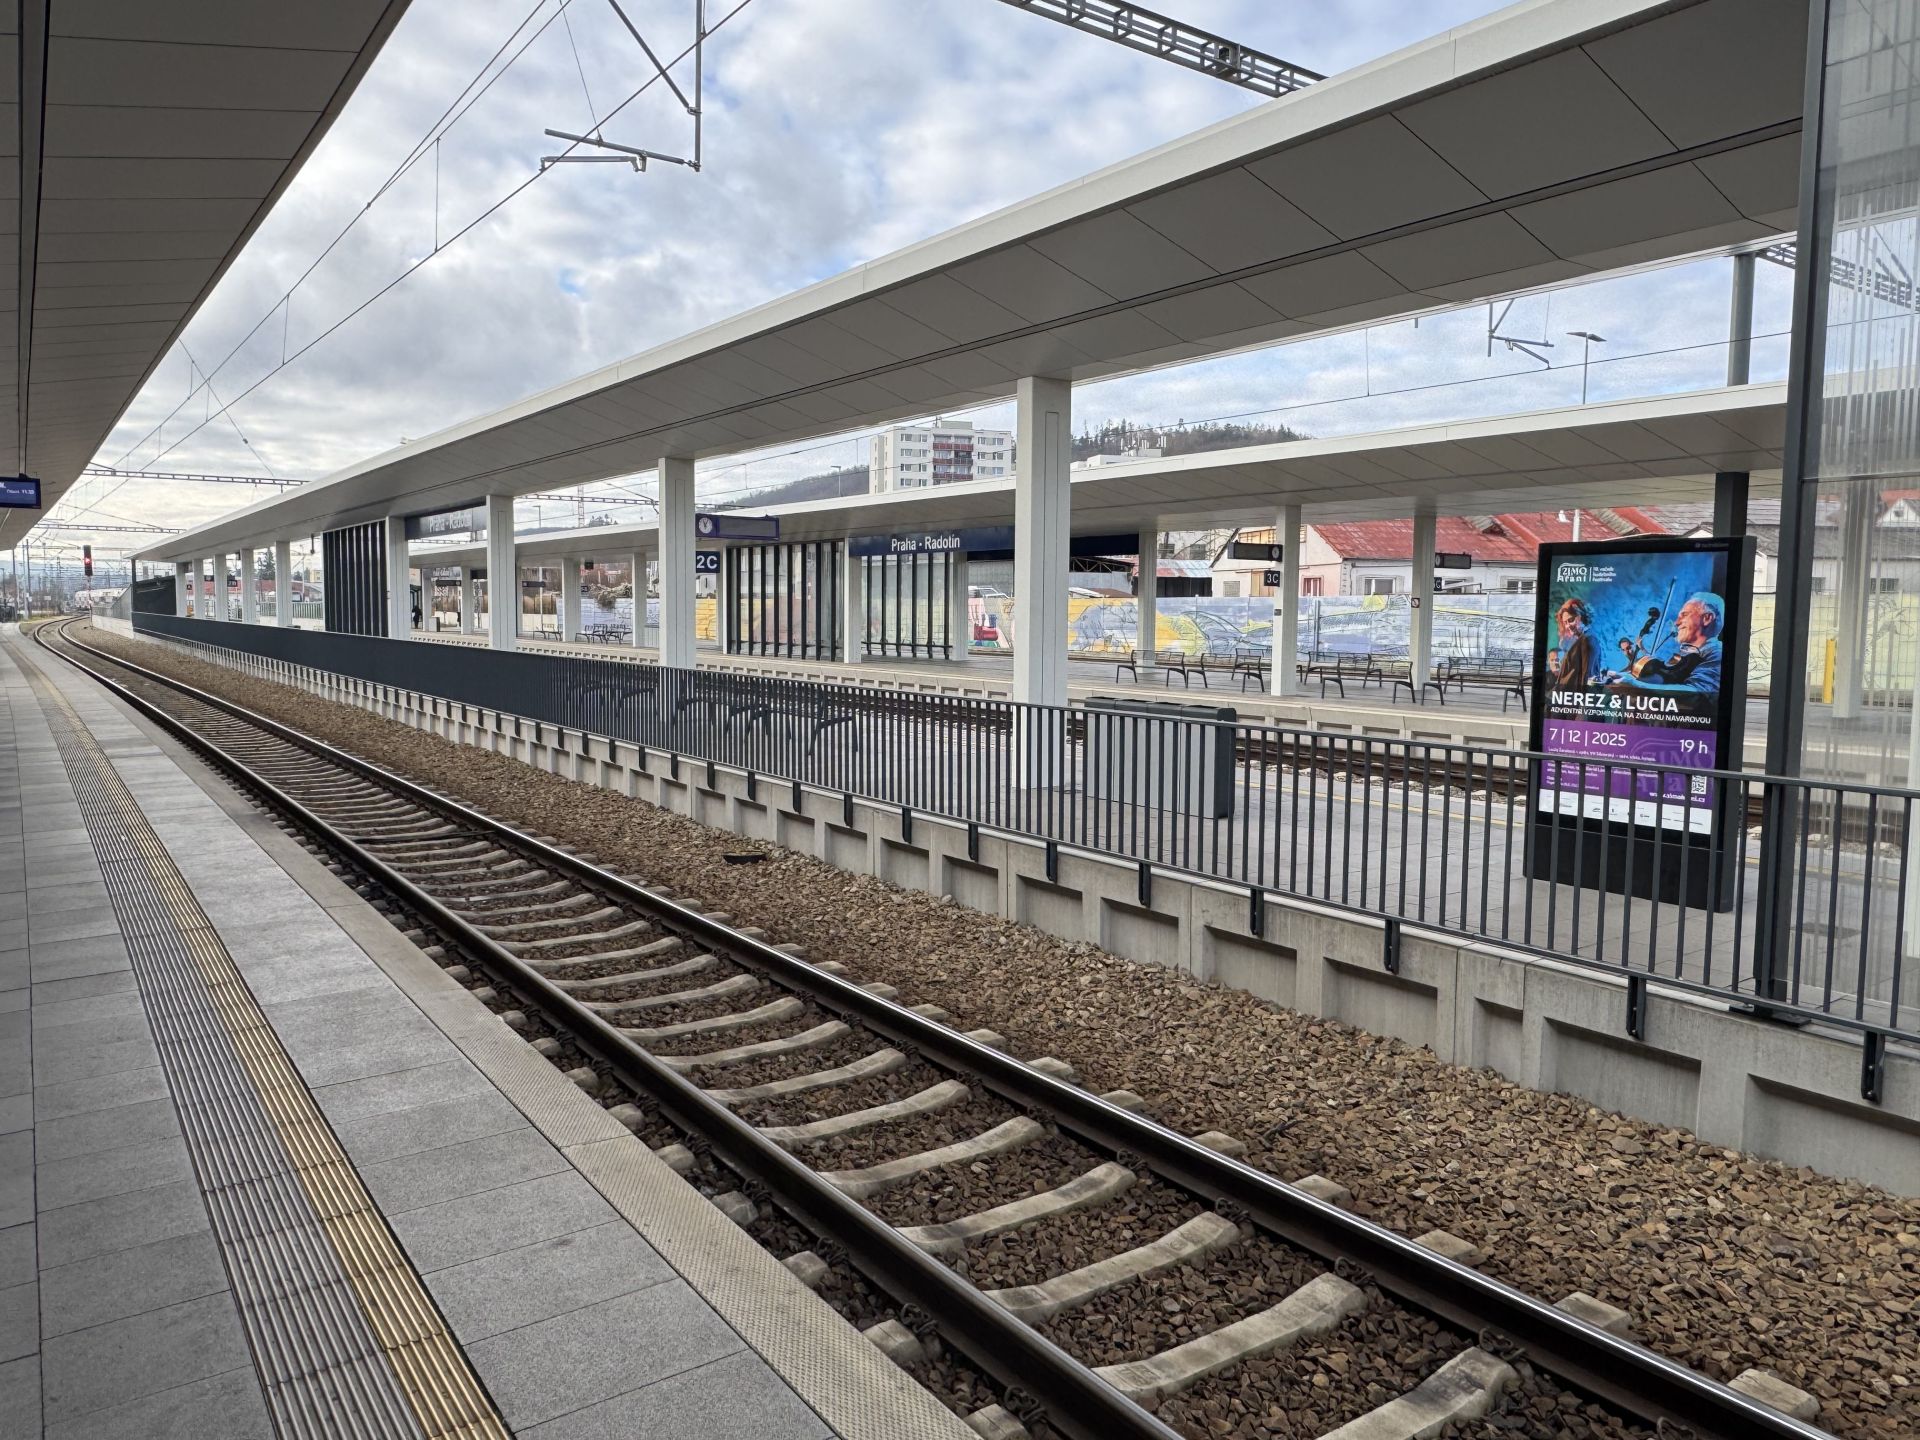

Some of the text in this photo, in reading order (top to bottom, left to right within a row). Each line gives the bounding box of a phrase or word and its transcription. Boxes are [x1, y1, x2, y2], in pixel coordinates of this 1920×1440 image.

[891, 538, 916, 552] Praha
[924, 533, 961, 550] Radotín
[696, 554, 718, 570] 2C
[1266, 573, 1279, 584] 3C
[1551, 690, 1679, 713] NEREZ & LUCIA
[1624, 711, 1635, 720] NA
[1635, 712, 1665, 721] ZUZANU
[1665, 714, 1712, 725] NAVAROVOU
[1549, 728, 1558, 741] 7
[1567, 729, 1581, 742] 12
[1591, 731, 1627, 747] 2025
[1679, 739, 1709, 755] 19 h
